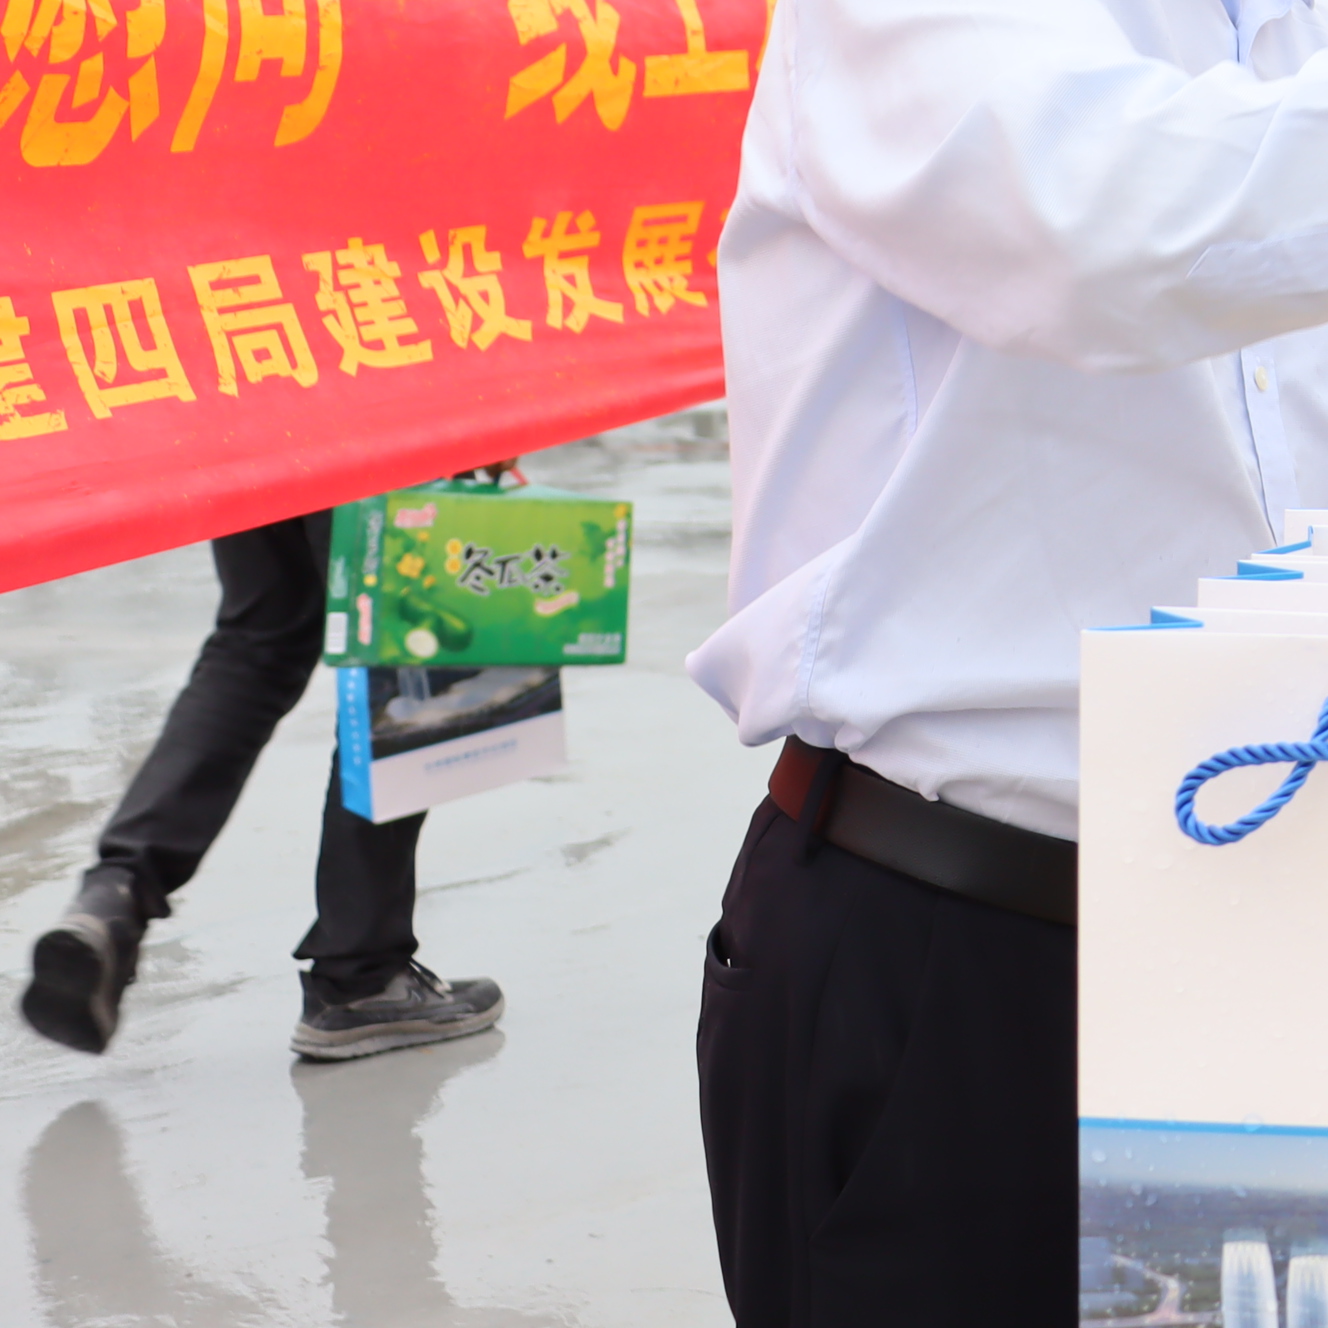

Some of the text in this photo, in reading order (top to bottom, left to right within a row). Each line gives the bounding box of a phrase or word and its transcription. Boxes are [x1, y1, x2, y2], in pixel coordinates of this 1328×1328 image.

[0, 200, 731, 442] 四局建设发展
[457, 543, 572, 596] 冬瓜茶
